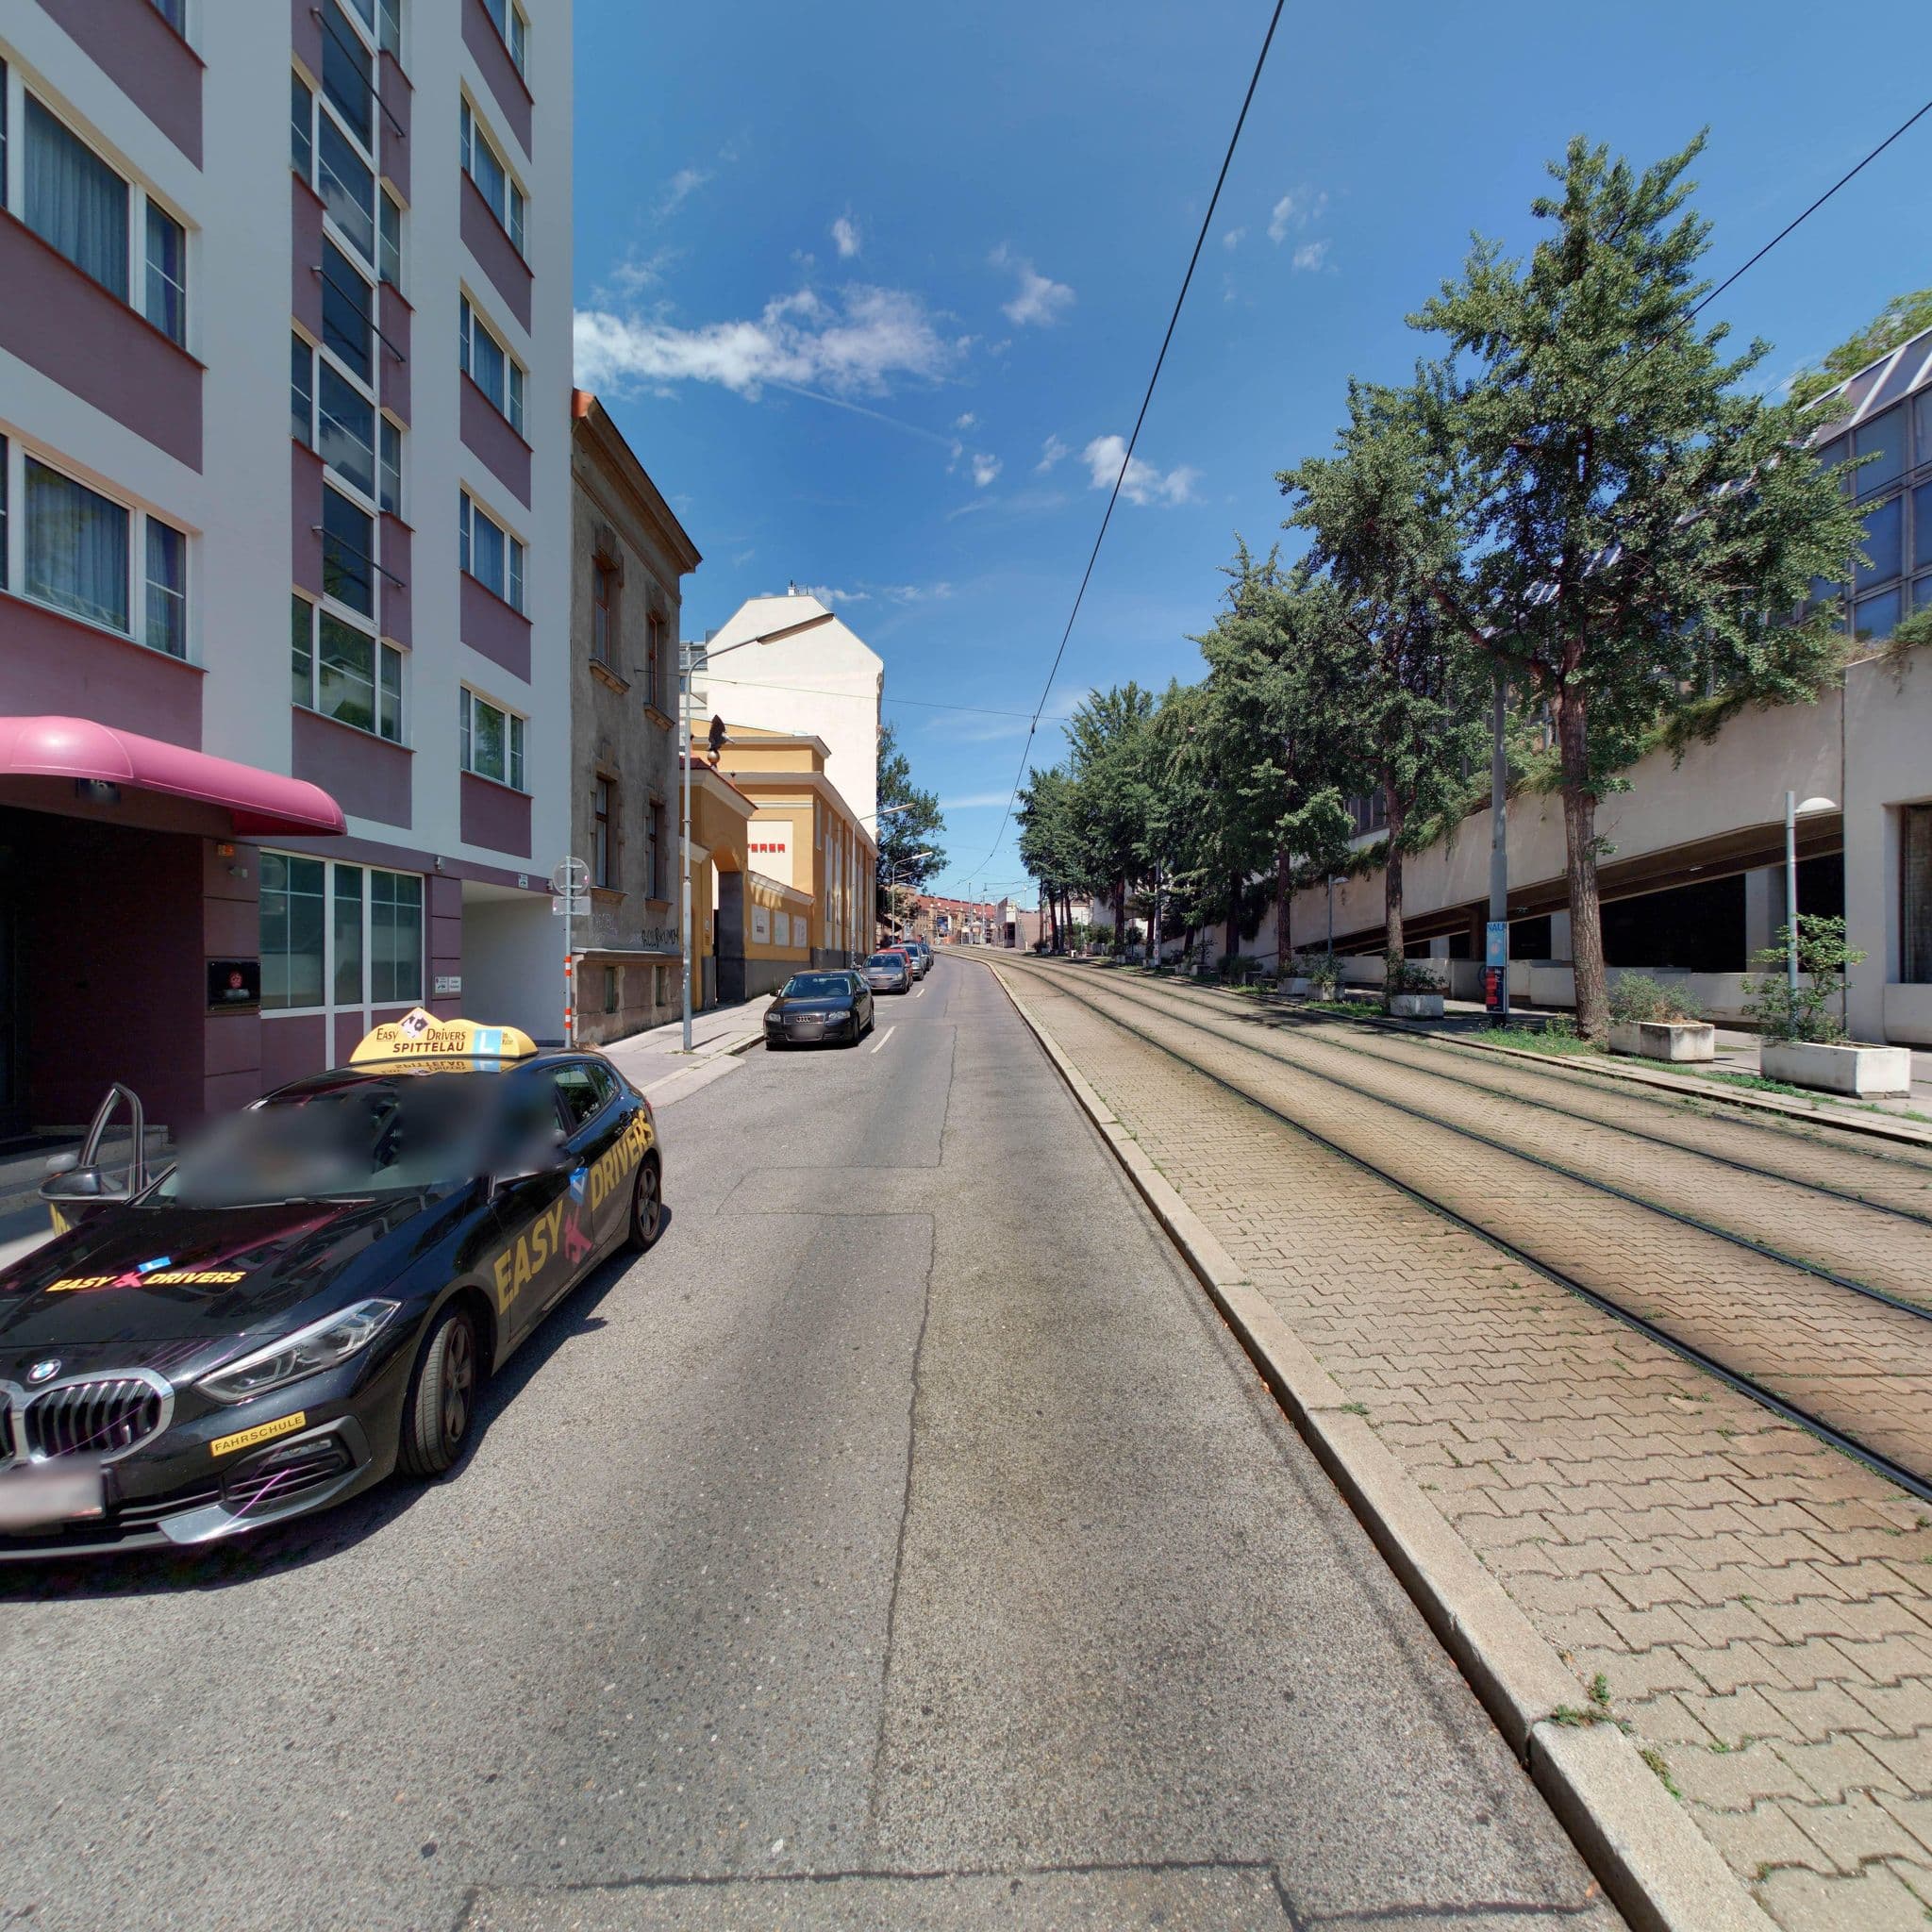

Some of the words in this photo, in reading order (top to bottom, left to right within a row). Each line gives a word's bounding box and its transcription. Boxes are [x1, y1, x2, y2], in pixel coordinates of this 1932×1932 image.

[748, 843, 785, 853] ERER
[376, 1028, 399, 1041] EASY
[481, 1031, 495, 1054] L
[392, 1041, 465, 1053] SPITTELAU
[493, 1200, 563, 1316] EASY
[589, 1122, 655, 1211] DRIVERS
[45, 1275, 118, 1292] EASY
[142, 1272, 247, 1285] DRIVERS
[214, 1416, 304, 1452] FAHRSCHULE
